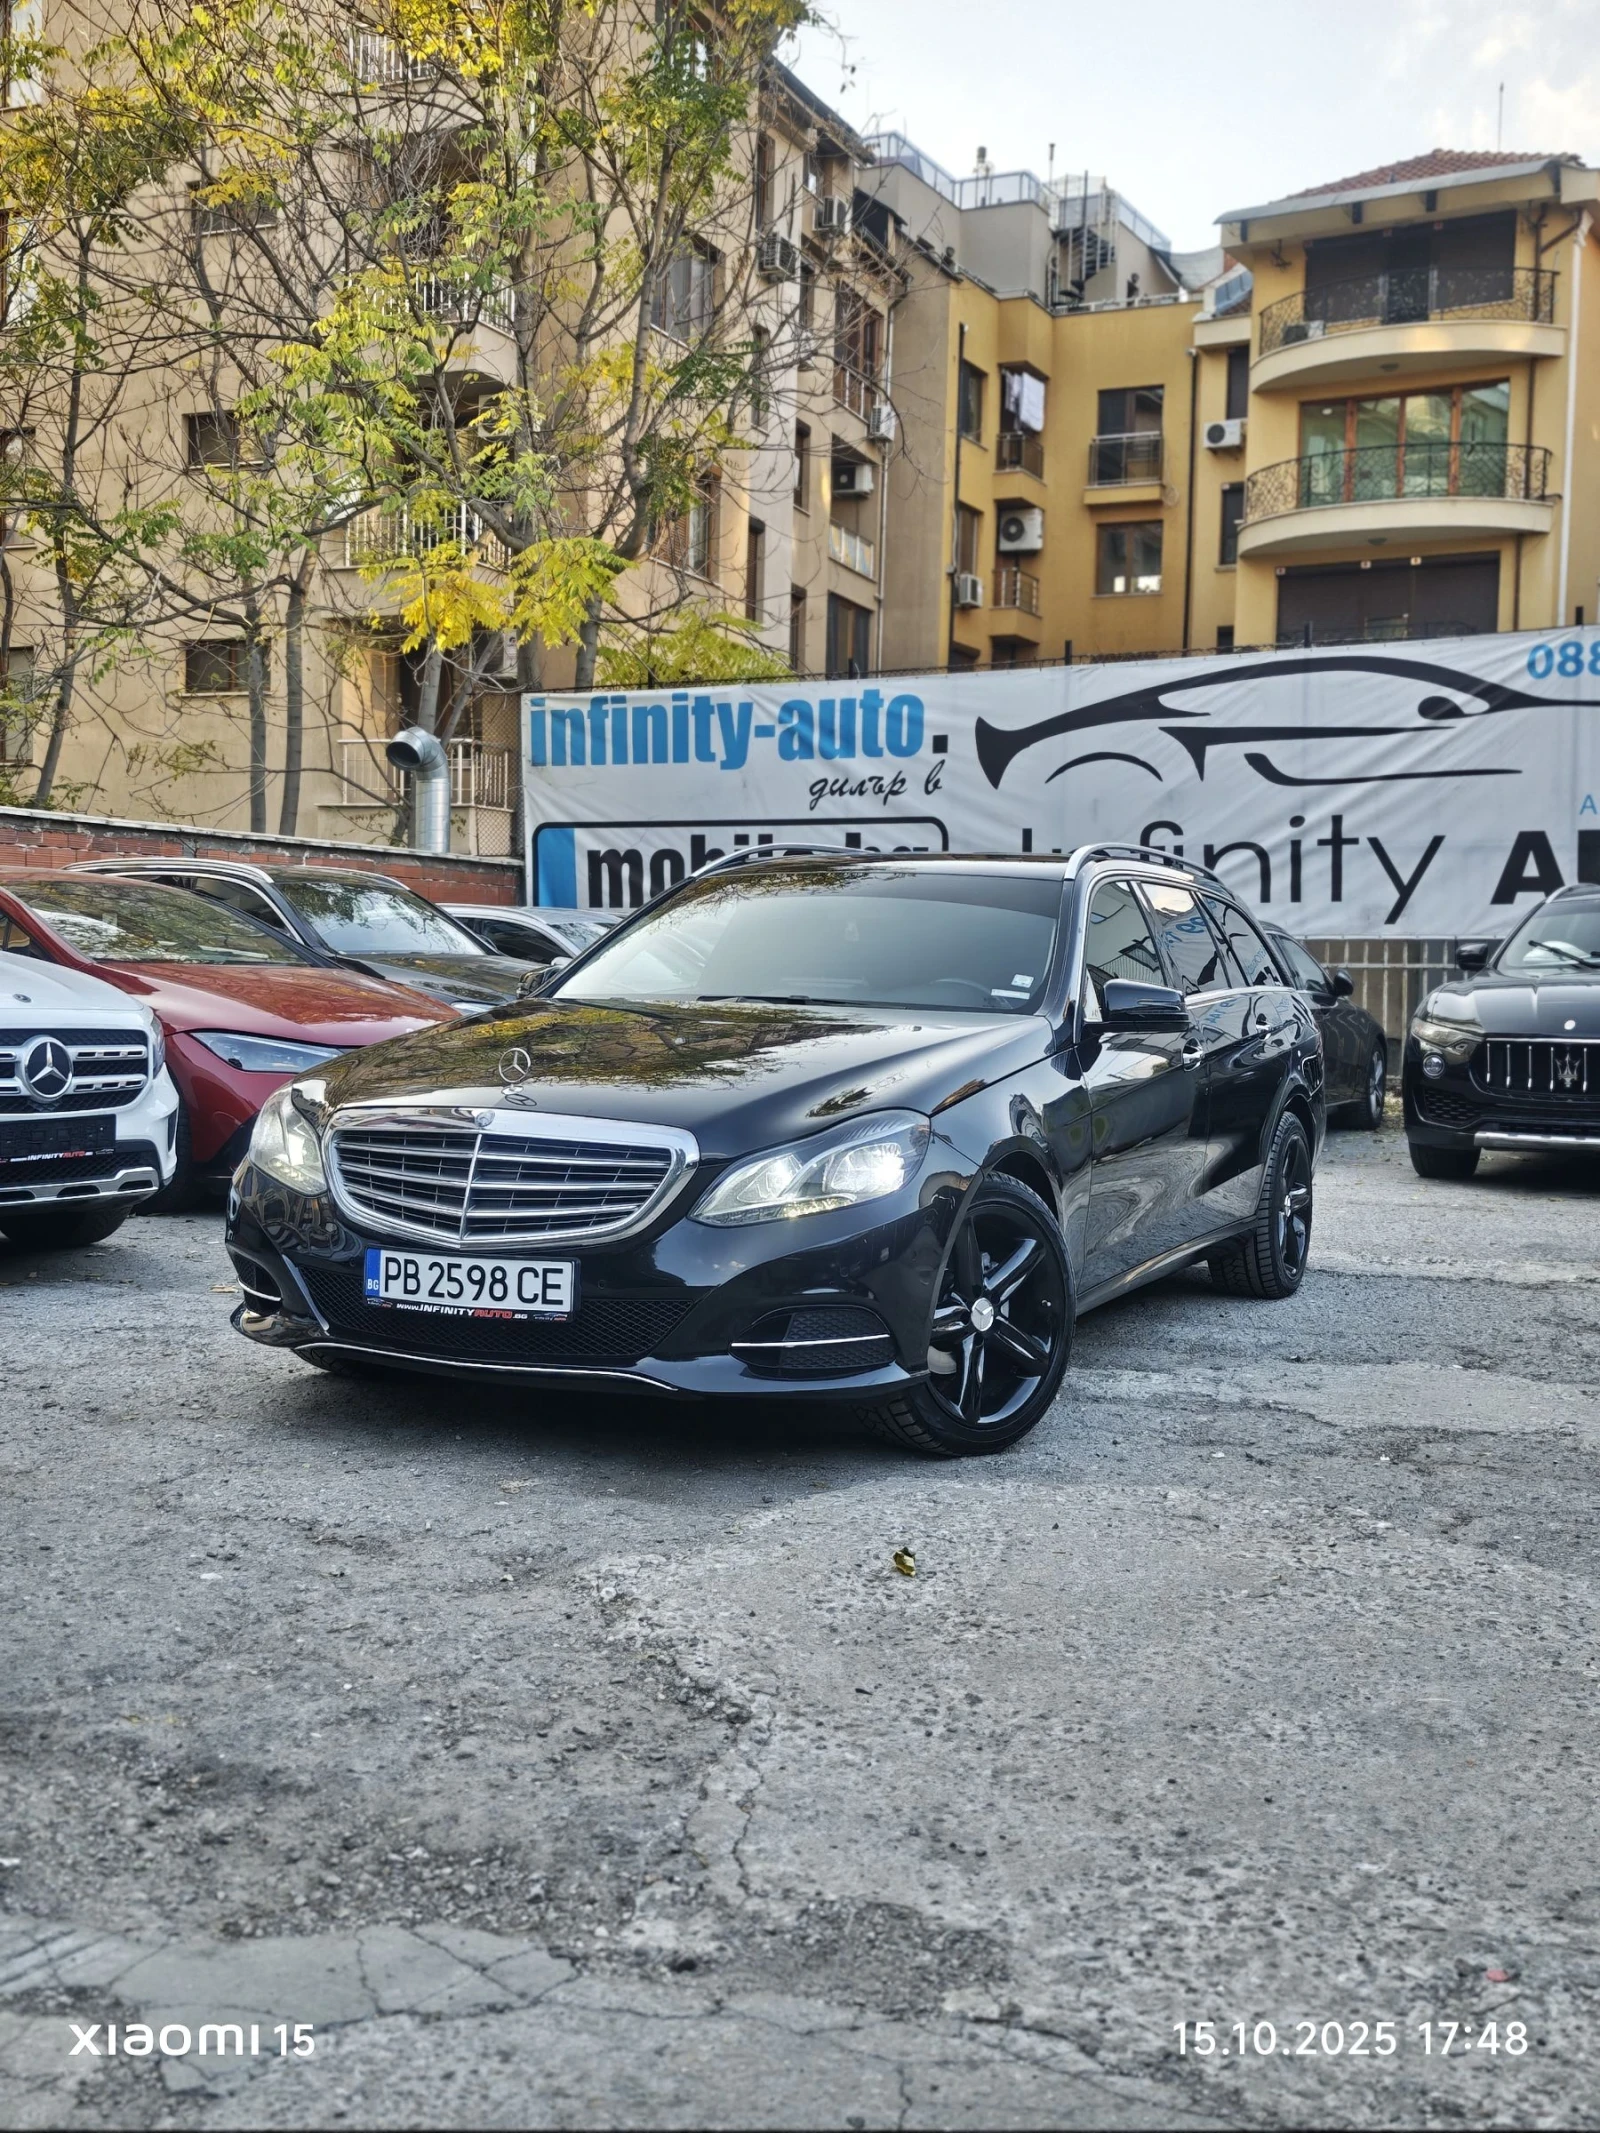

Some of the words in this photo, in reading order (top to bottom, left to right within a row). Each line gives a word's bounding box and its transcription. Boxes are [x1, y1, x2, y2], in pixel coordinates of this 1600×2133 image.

[809, 770, 908, 811] дилър
[366, 1278, 379, 1291] BG
[384, 1256, 421, 1296] PB
[427, 1261, 509, 1302] 2598
[517, 1266, 564, 1306] CE
